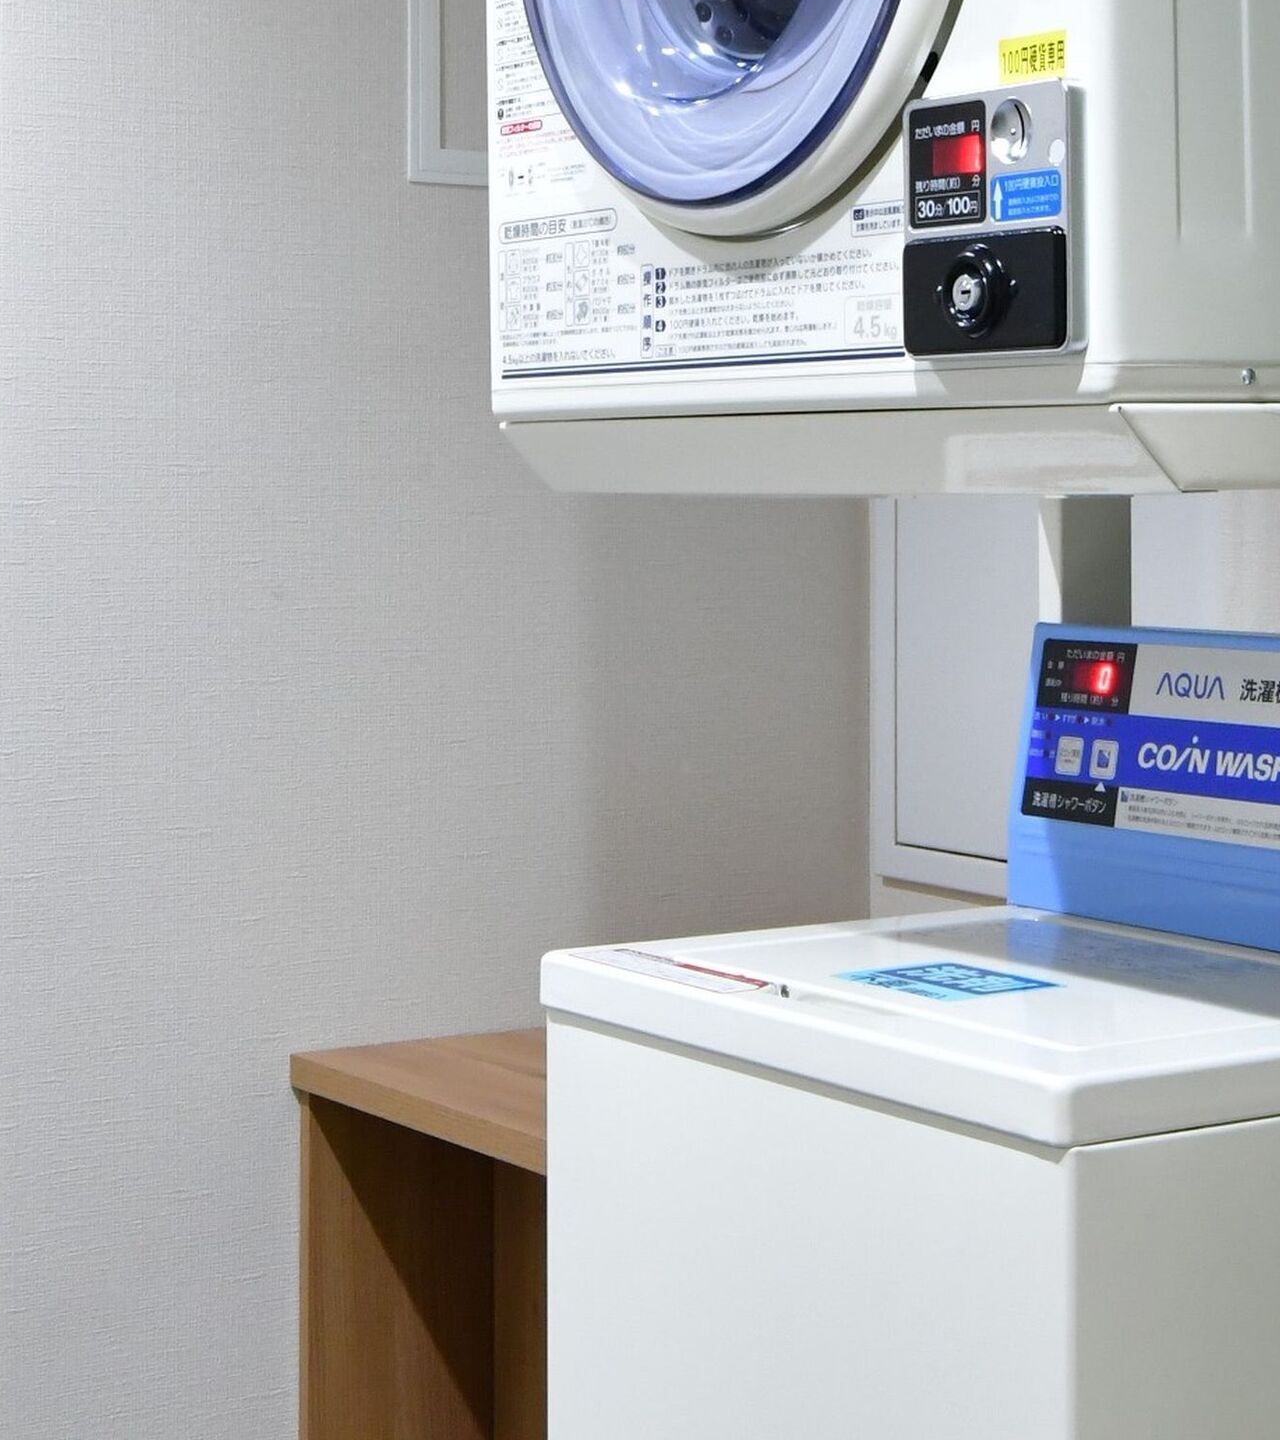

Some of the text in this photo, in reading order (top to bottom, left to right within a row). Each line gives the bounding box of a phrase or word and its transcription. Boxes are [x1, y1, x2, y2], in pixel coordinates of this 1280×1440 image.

[971, 119, 980, 133] 円
[1097, 664, 1113, 695] 0
[1156, 671, 1225, 701] AQUA
[1137, 736, 1208, 775] COIN
